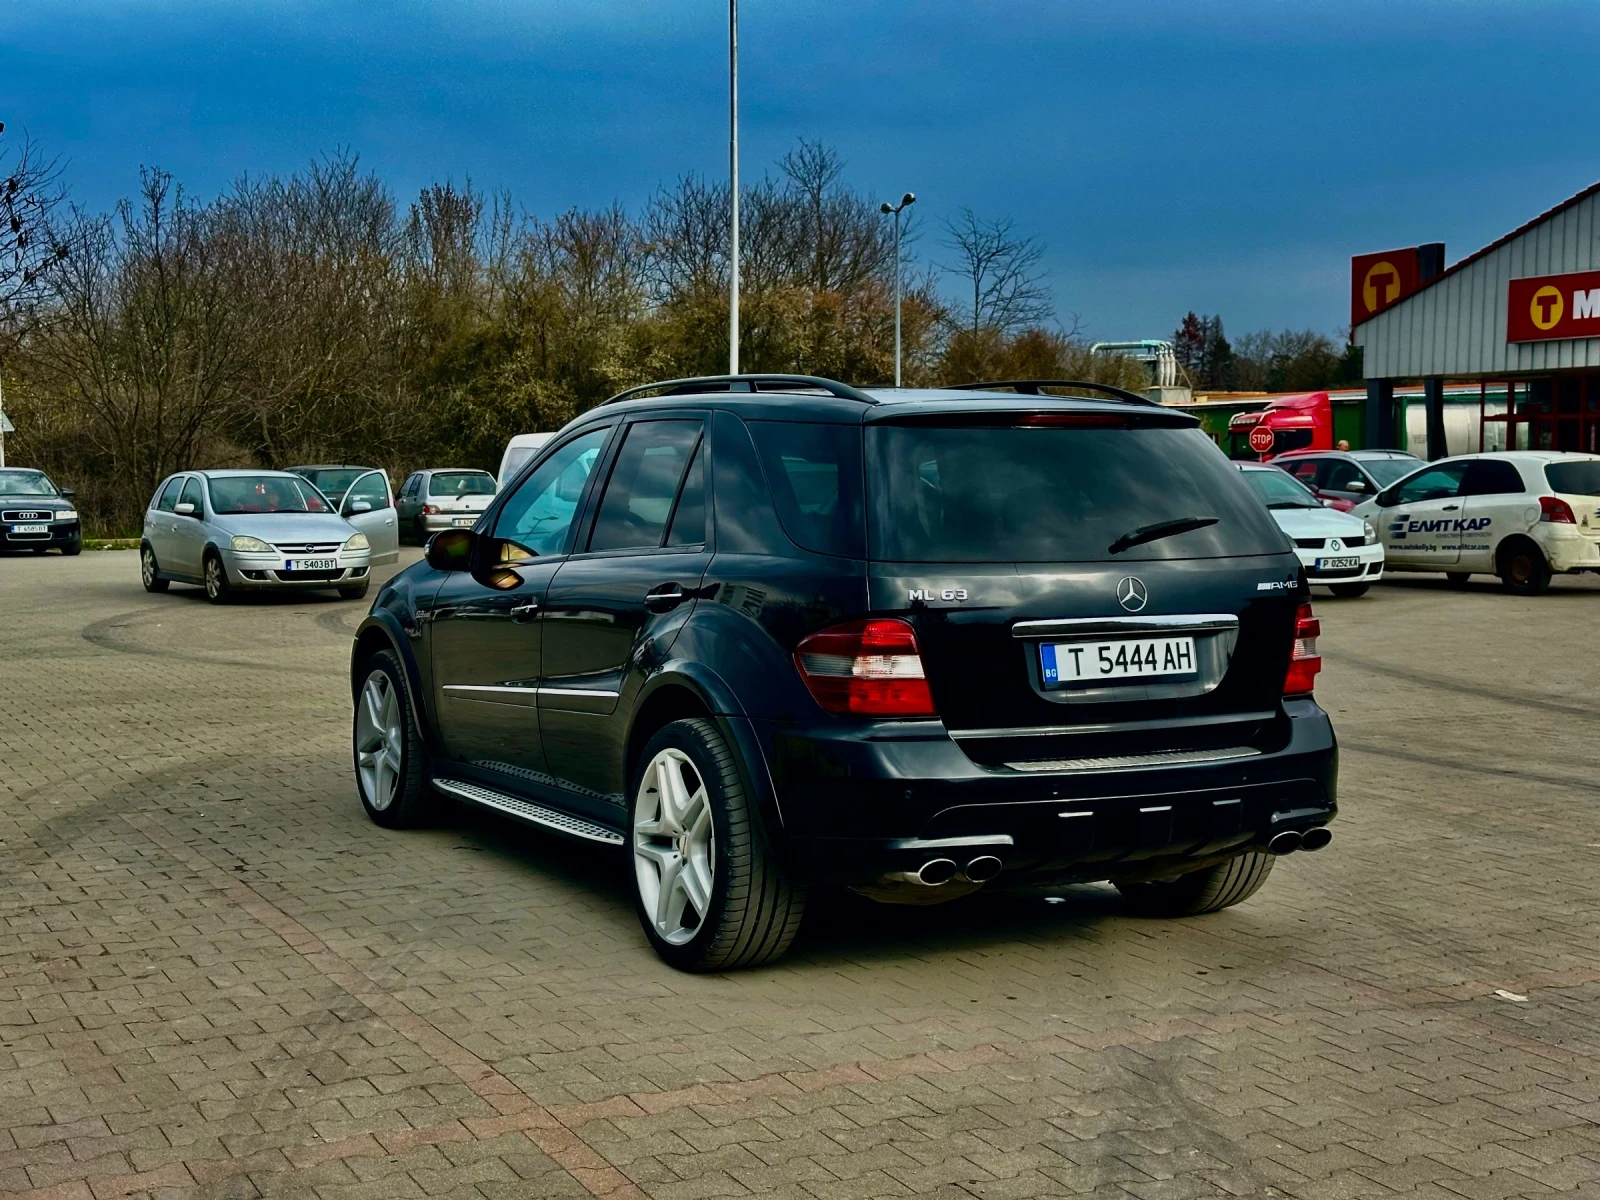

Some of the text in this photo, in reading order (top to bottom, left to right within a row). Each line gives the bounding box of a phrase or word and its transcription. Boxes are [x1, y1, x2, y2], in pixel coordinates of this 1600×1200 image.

[1251, 434, 1272, 445] STOP
[1270, 580, 1298, 590] AMG
[908, 588, 968, 601] ML 63
[1068, 647, 1084, 676] T
[1045, 668, 1057, 678] BG
